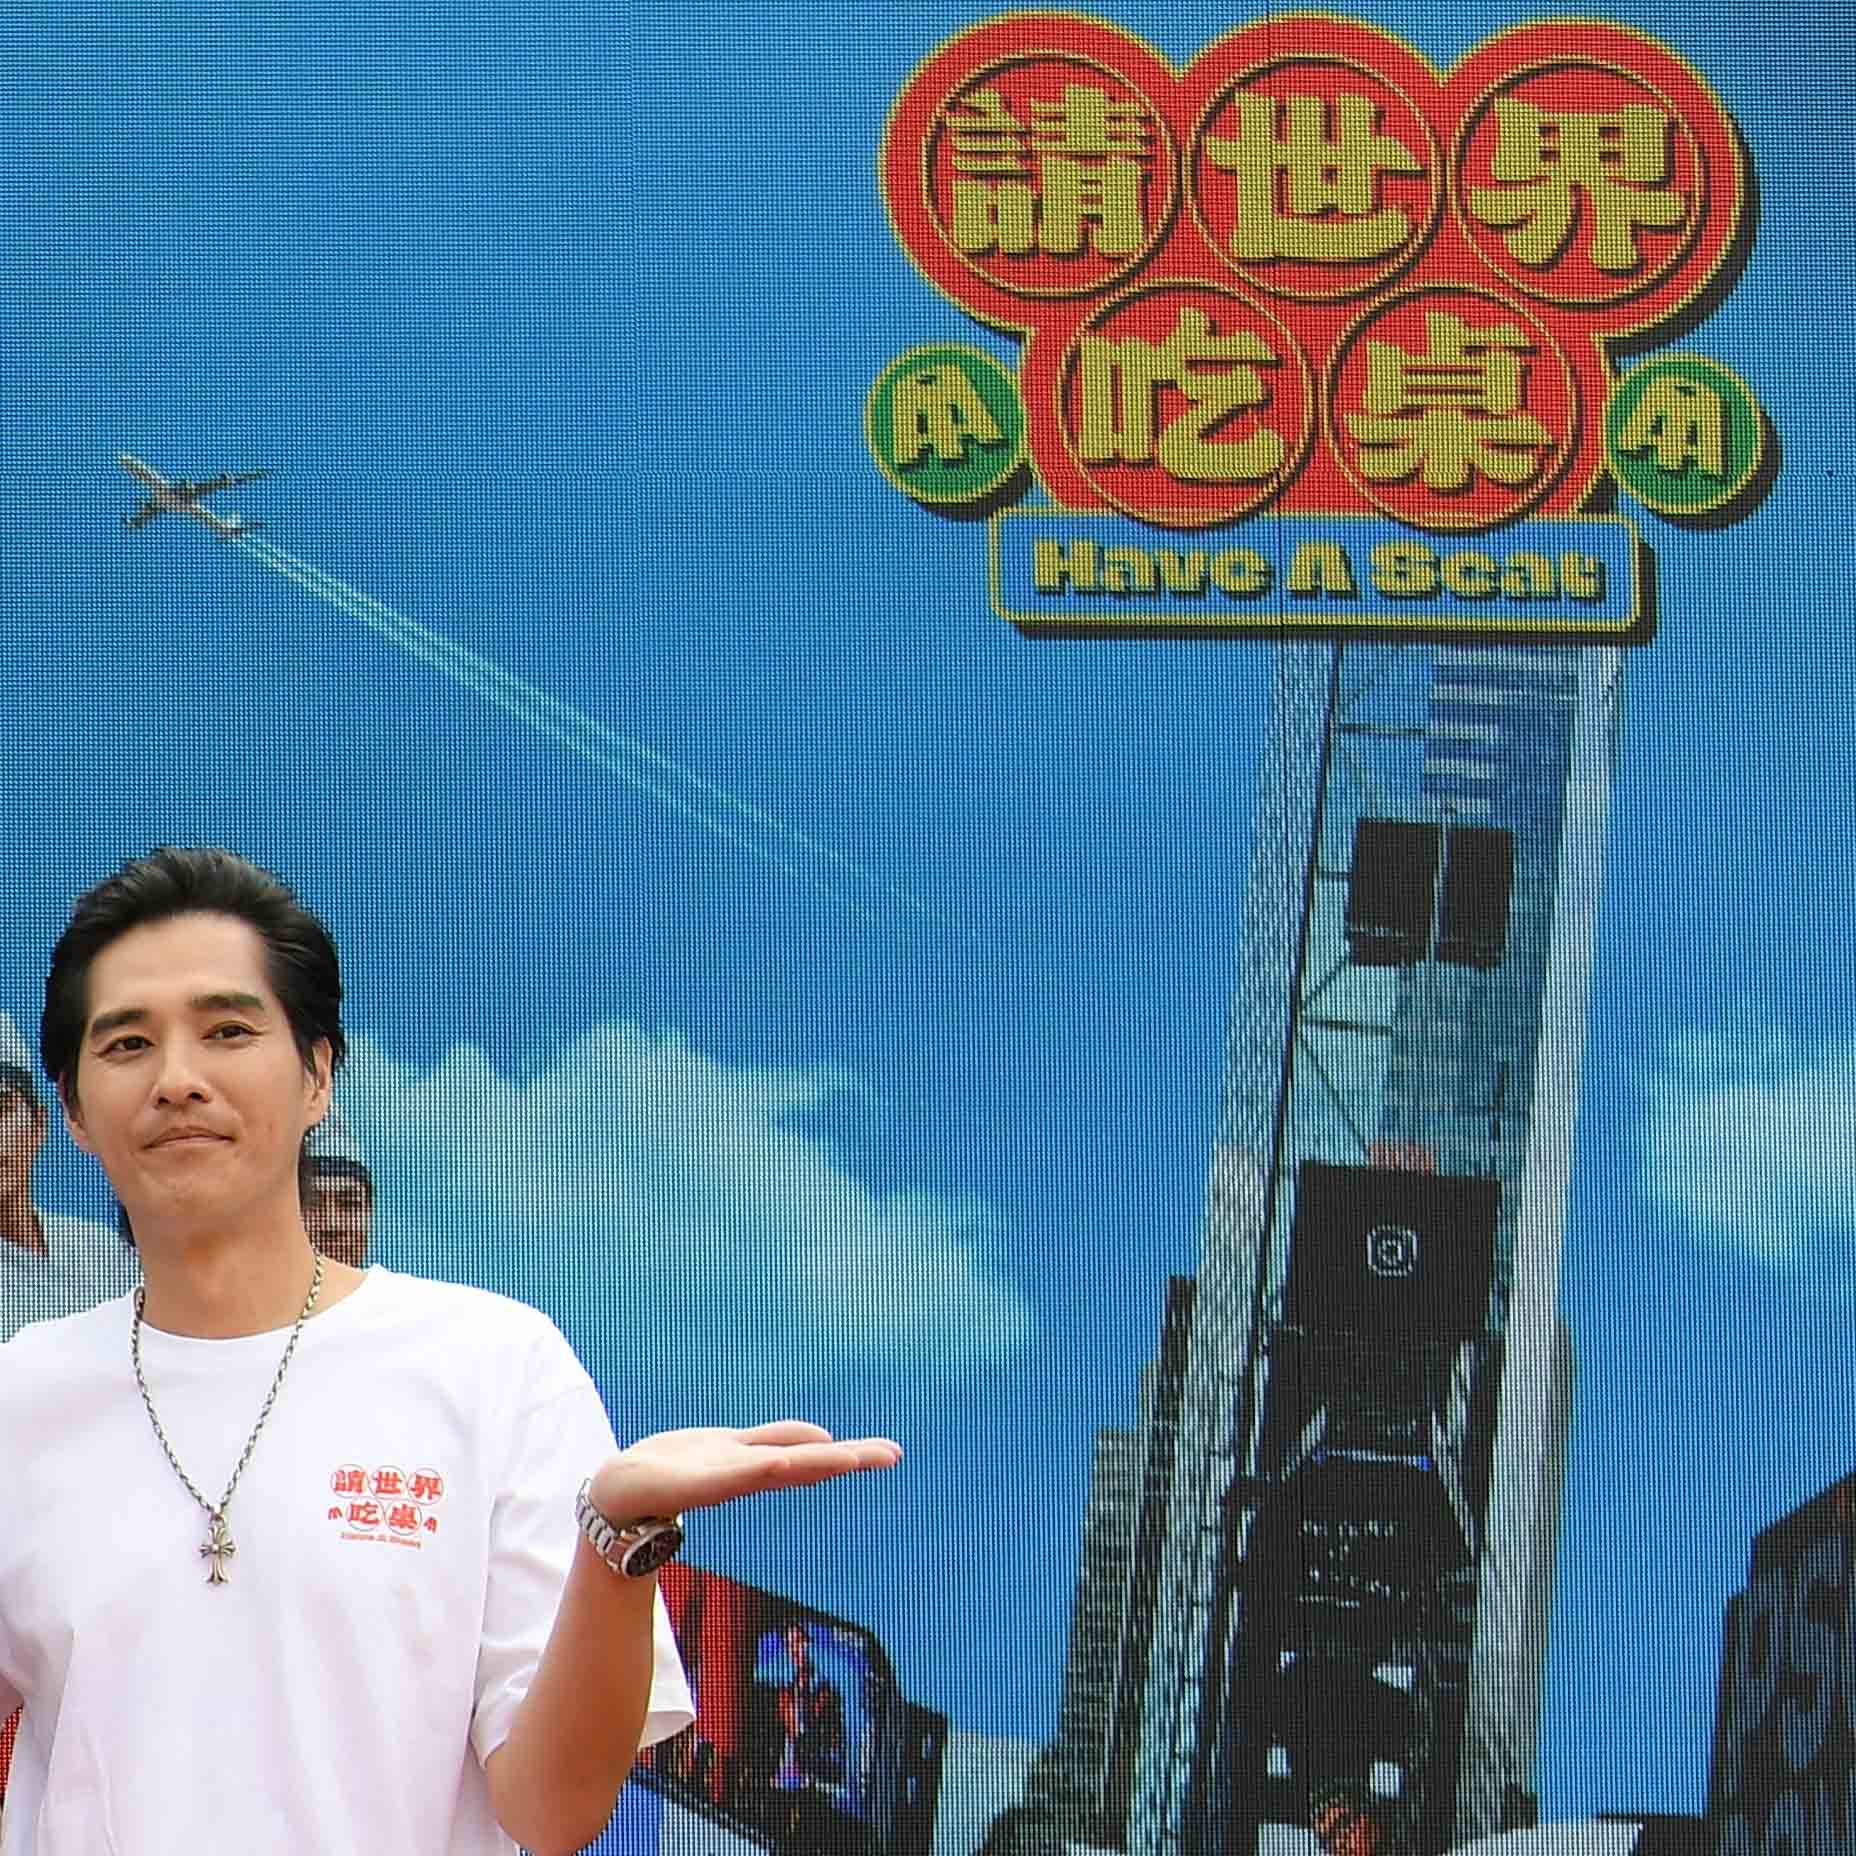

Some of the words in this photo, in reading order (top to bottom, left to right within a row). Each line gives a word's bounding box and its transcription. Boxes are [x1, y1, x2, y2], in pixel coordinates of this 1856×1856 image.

[944, 83, 1686, 271] 請世界
[1077, 305, 1556, 489] 吃桌
[1034, 541, 1270, 594] Have
[1286, 542, 1354, 594] A
[1370, 541, 1602, 598] Seat
